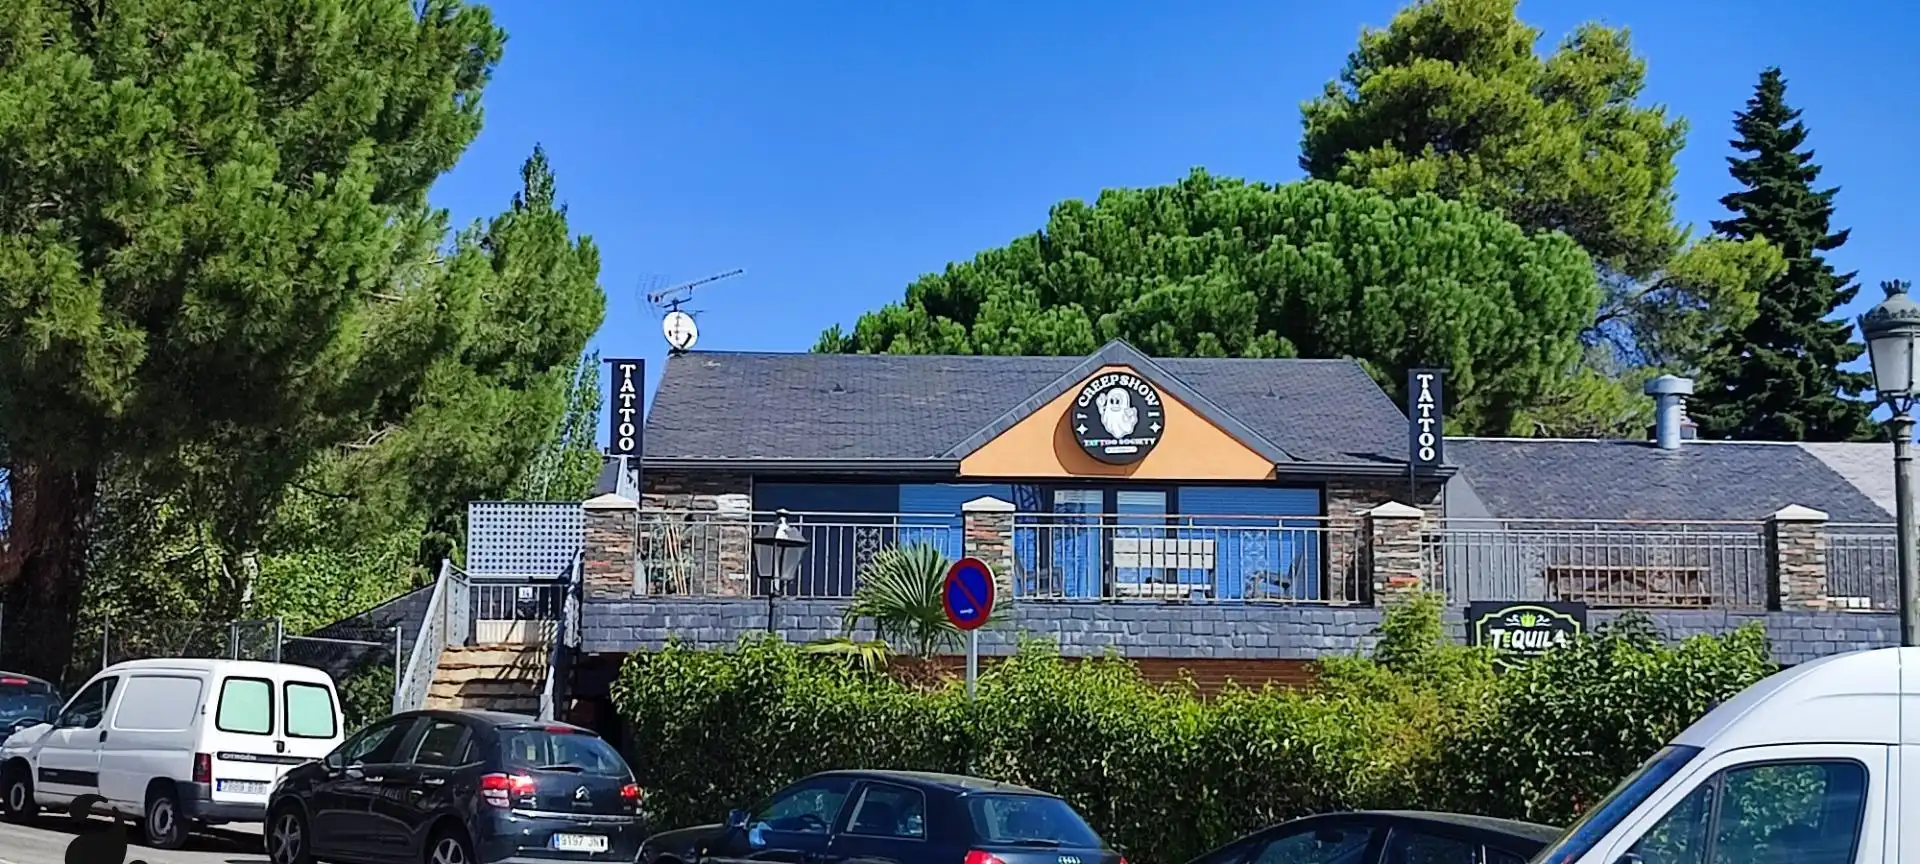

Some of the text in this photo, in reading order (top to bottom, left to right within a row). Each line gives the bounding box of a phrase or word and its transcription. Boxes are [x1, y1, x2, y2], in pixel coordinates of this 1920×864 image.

[619, 364, 636, 451] TATTOO
[1078, 374, 1160, 407] CREEPSHOW
[1417, 374, 1435, 461] TATTOO
[1084, 437, 1156, 447] TATTOO SOCIETY
